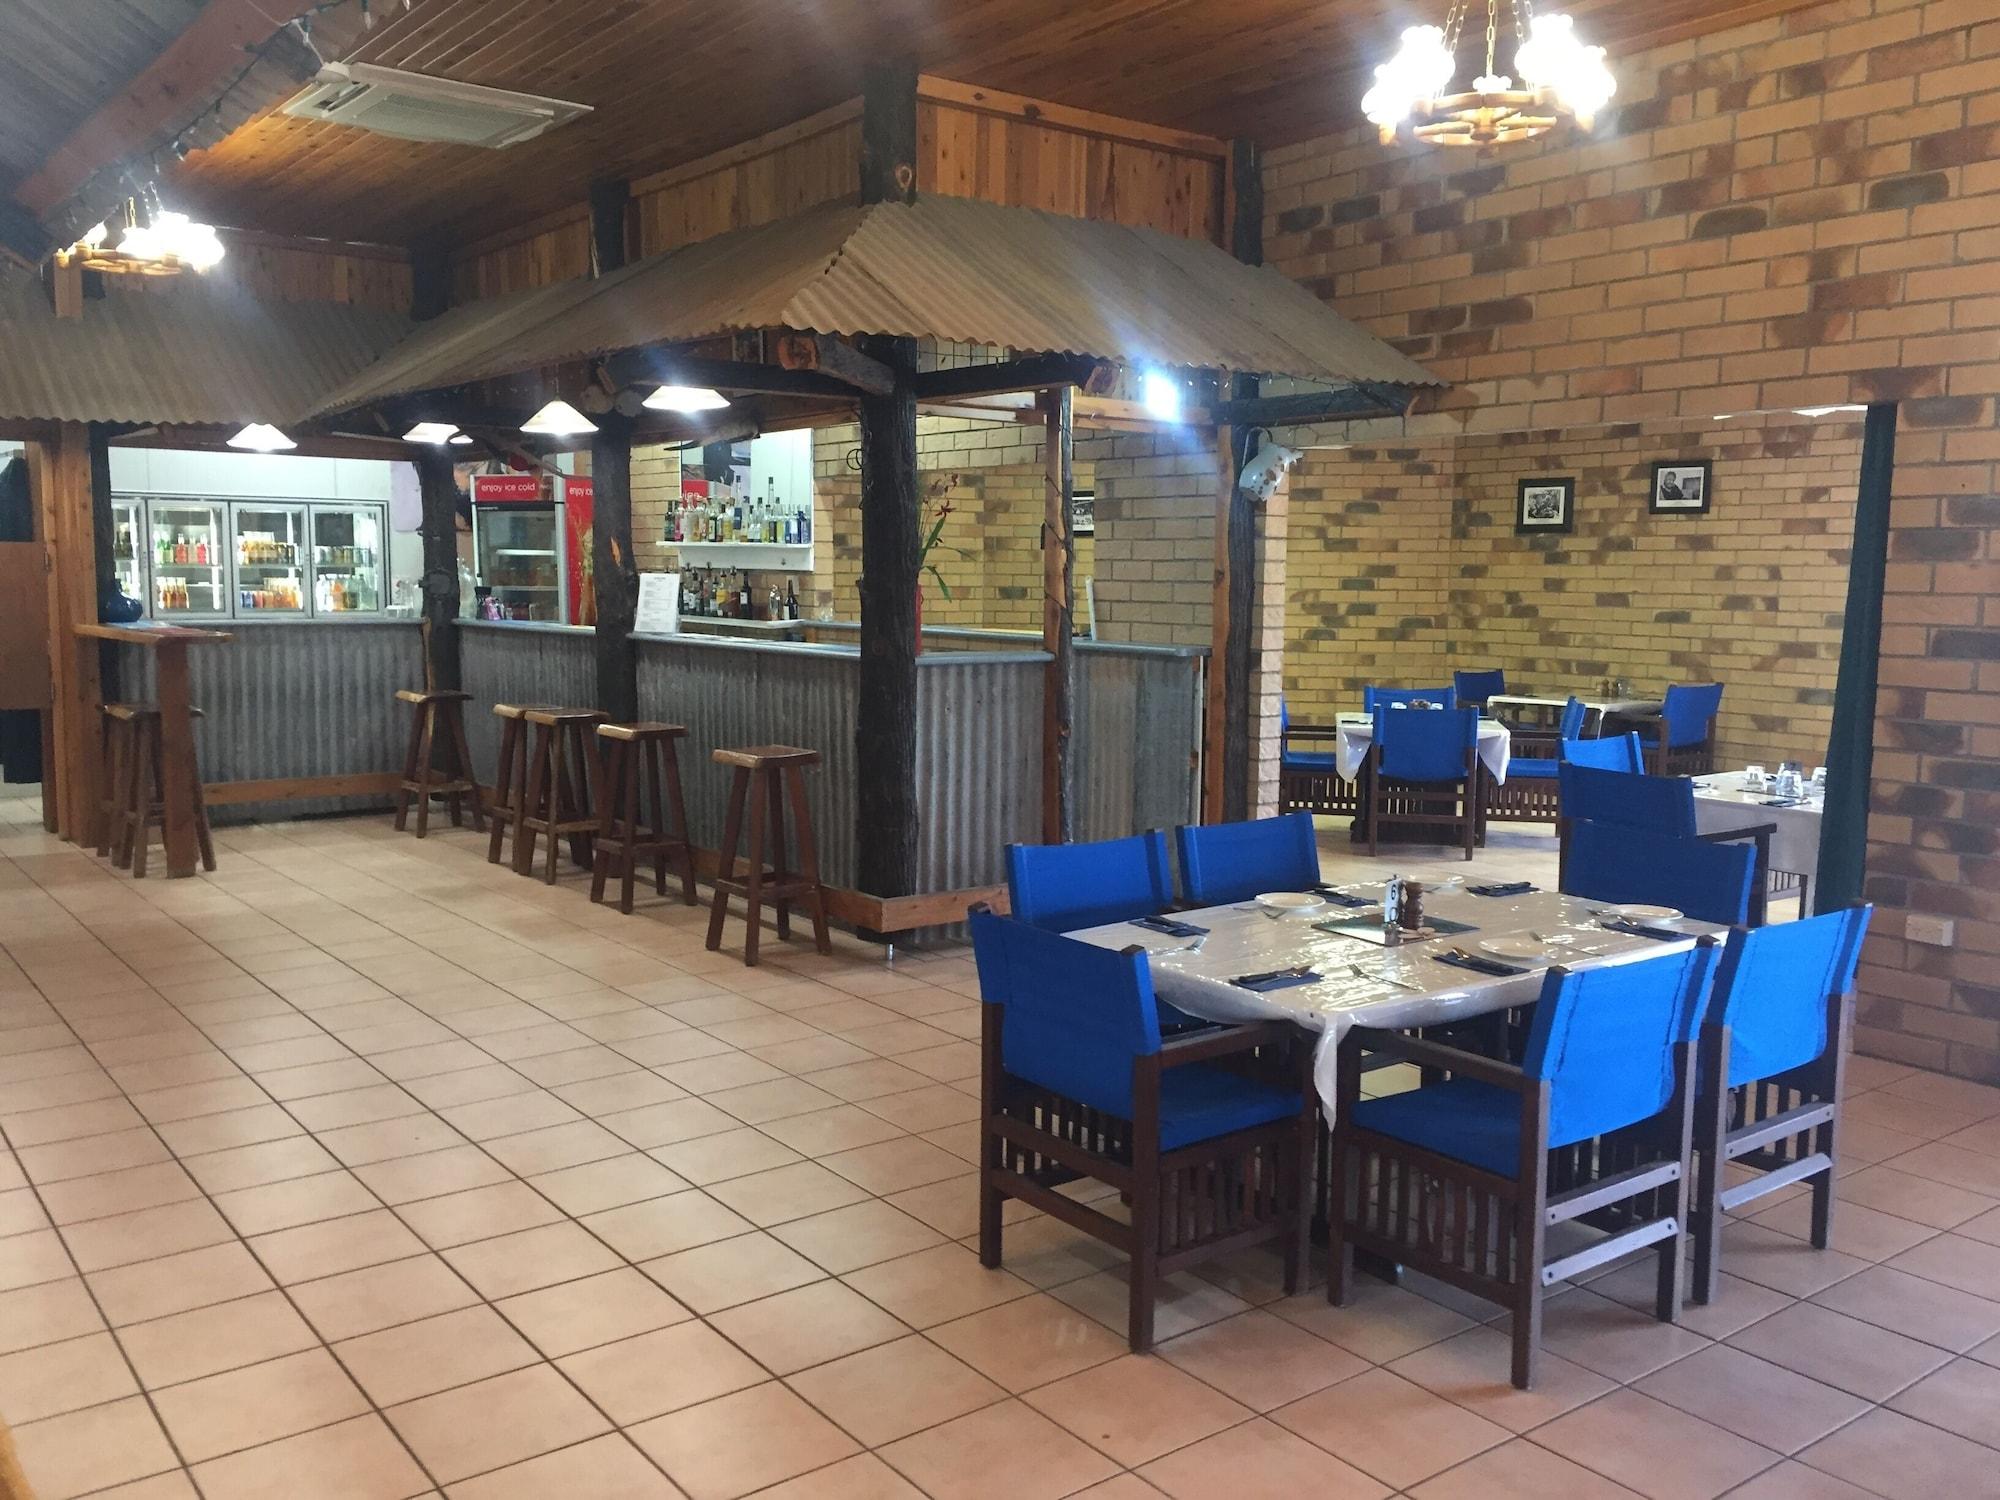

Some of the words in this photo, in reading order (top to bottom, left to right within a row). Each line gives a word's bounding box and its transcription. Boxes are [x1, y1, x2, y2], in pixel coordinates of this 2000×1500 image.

[481, 484, 502, 493] enjoy
[504, 483, 517, 492] ice
[518, 483, 535, 492] cold
[569, 487, 584, 497] enjoy
[1391, 884, 1397, 901] 6
